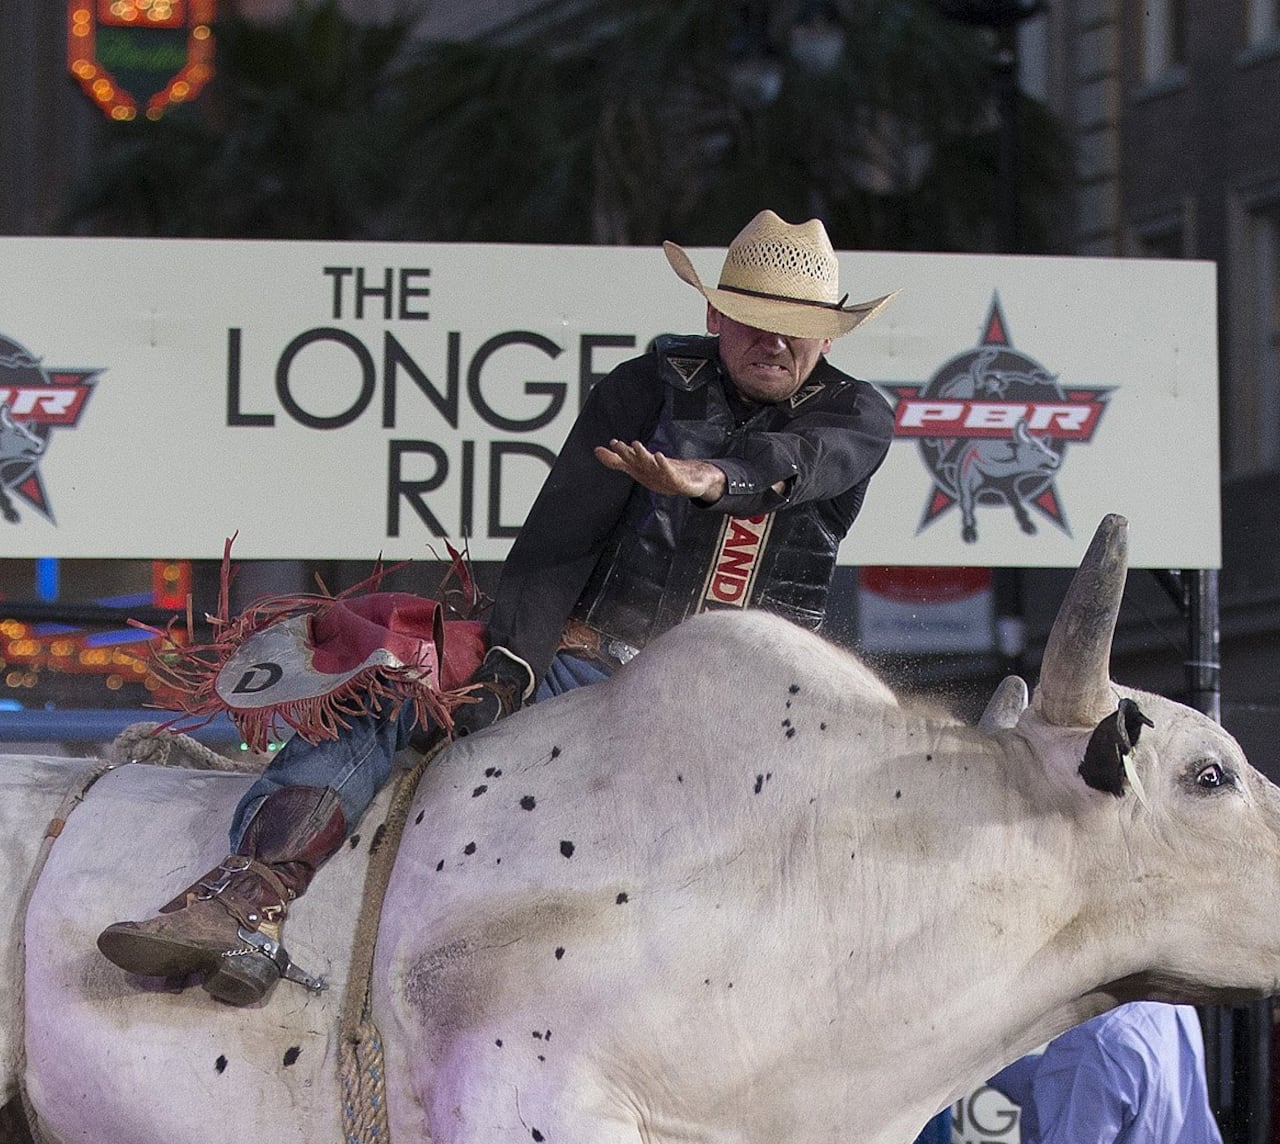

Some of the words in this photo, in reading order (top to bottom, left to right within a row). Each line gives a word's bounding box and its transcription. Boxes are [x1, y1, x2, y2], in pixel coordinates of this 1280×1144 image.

[323, 266, 431, 321] THE
[226, 326, 637, 433] LONGE
[899, 402, 1093, 431] PBR
[386, 439, 558, 540] RID
[711, 515, 766, 602] AND
[232, 662, 283, 694] D
